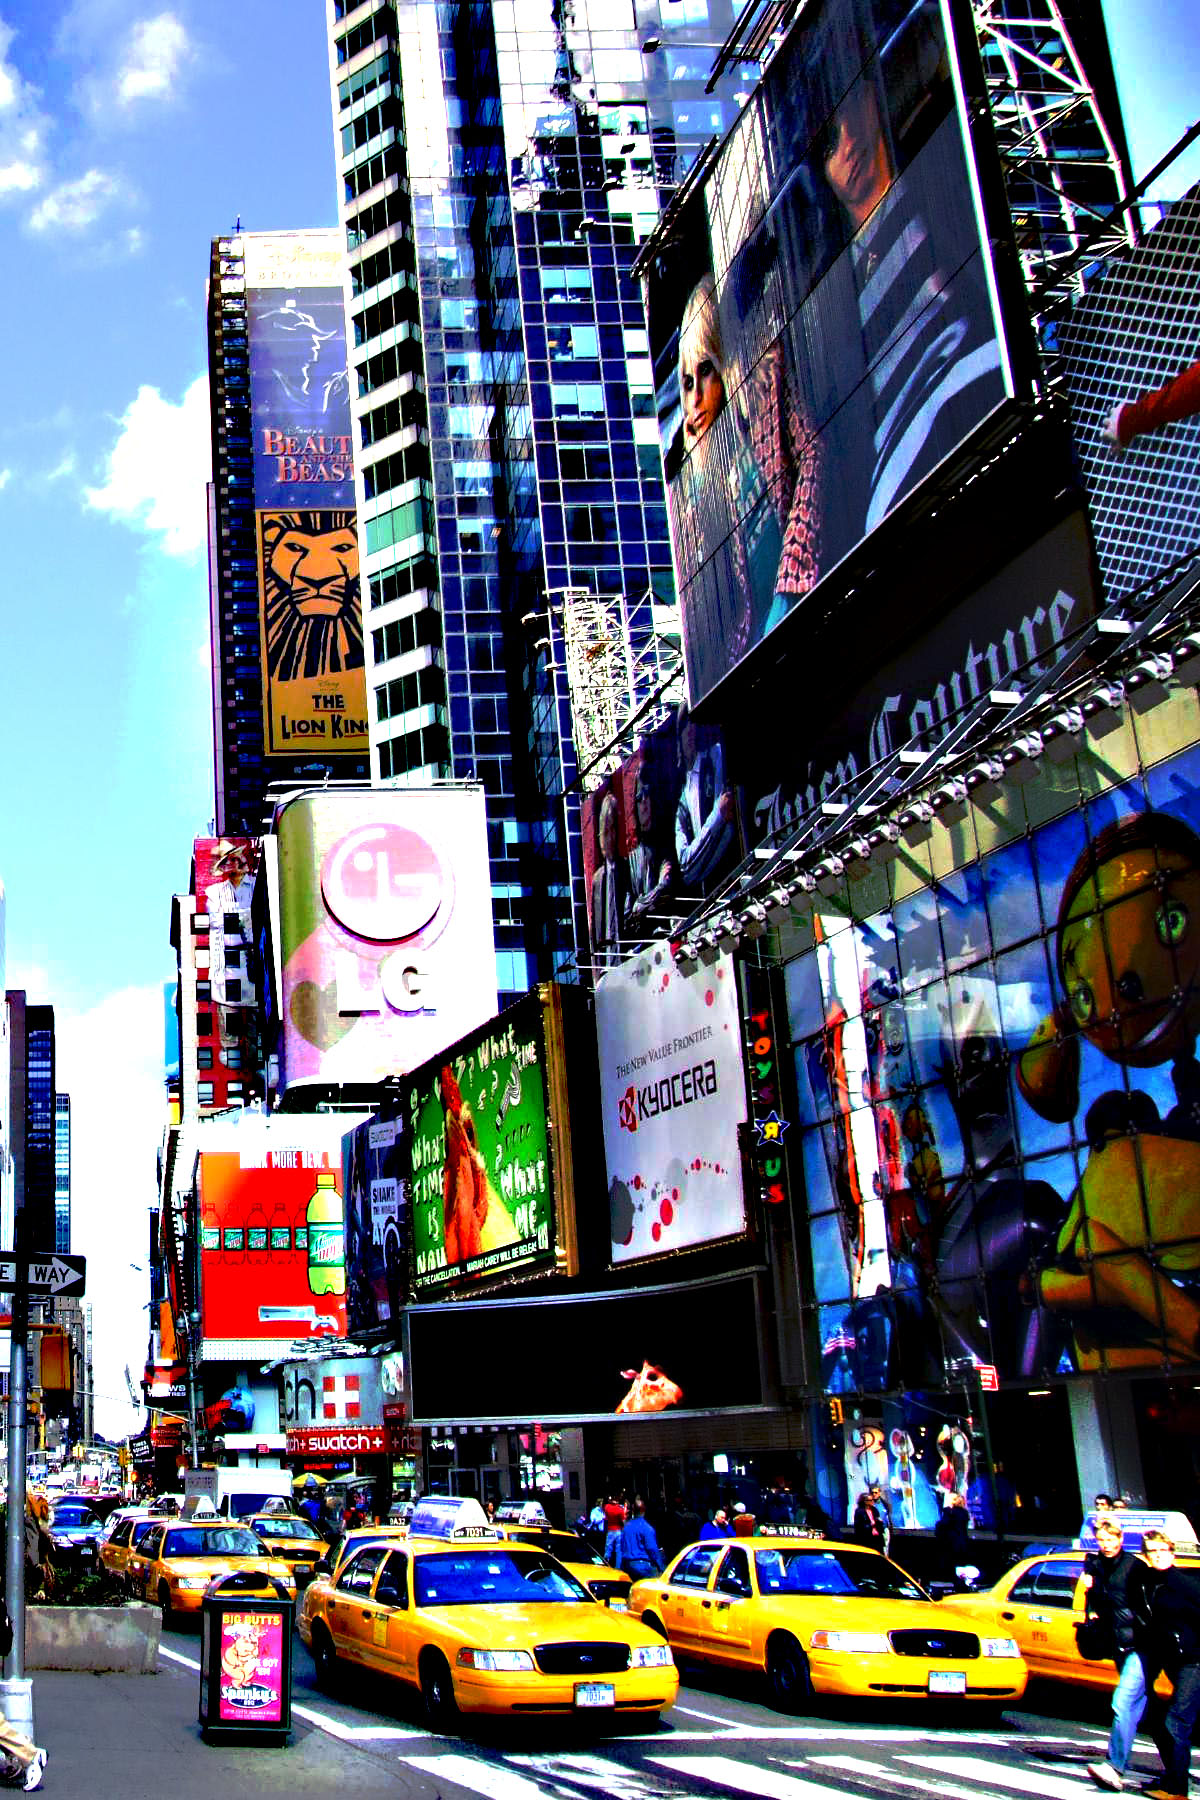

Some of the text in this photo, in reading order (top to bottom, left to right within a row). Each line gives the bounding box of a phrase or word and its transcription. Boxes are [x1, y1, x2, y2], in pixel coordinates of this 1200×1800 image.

[262, 427, 352, 456] BEAUT
[311, 694, 345, 709] THE
[281, 715, 326, 739] LION
[616, 1025, 713, 1079] THE NEW VALUE FRONTIER
[637, 1059, 719, 1121] KYOCERA
[272, 1151, 298, 1169] MORE
[34, 1265, 71, 1284] WAY
[308, 1433, 371, 1451] swatch
[222, 1614, 280, 1626] BIG BUTTS
